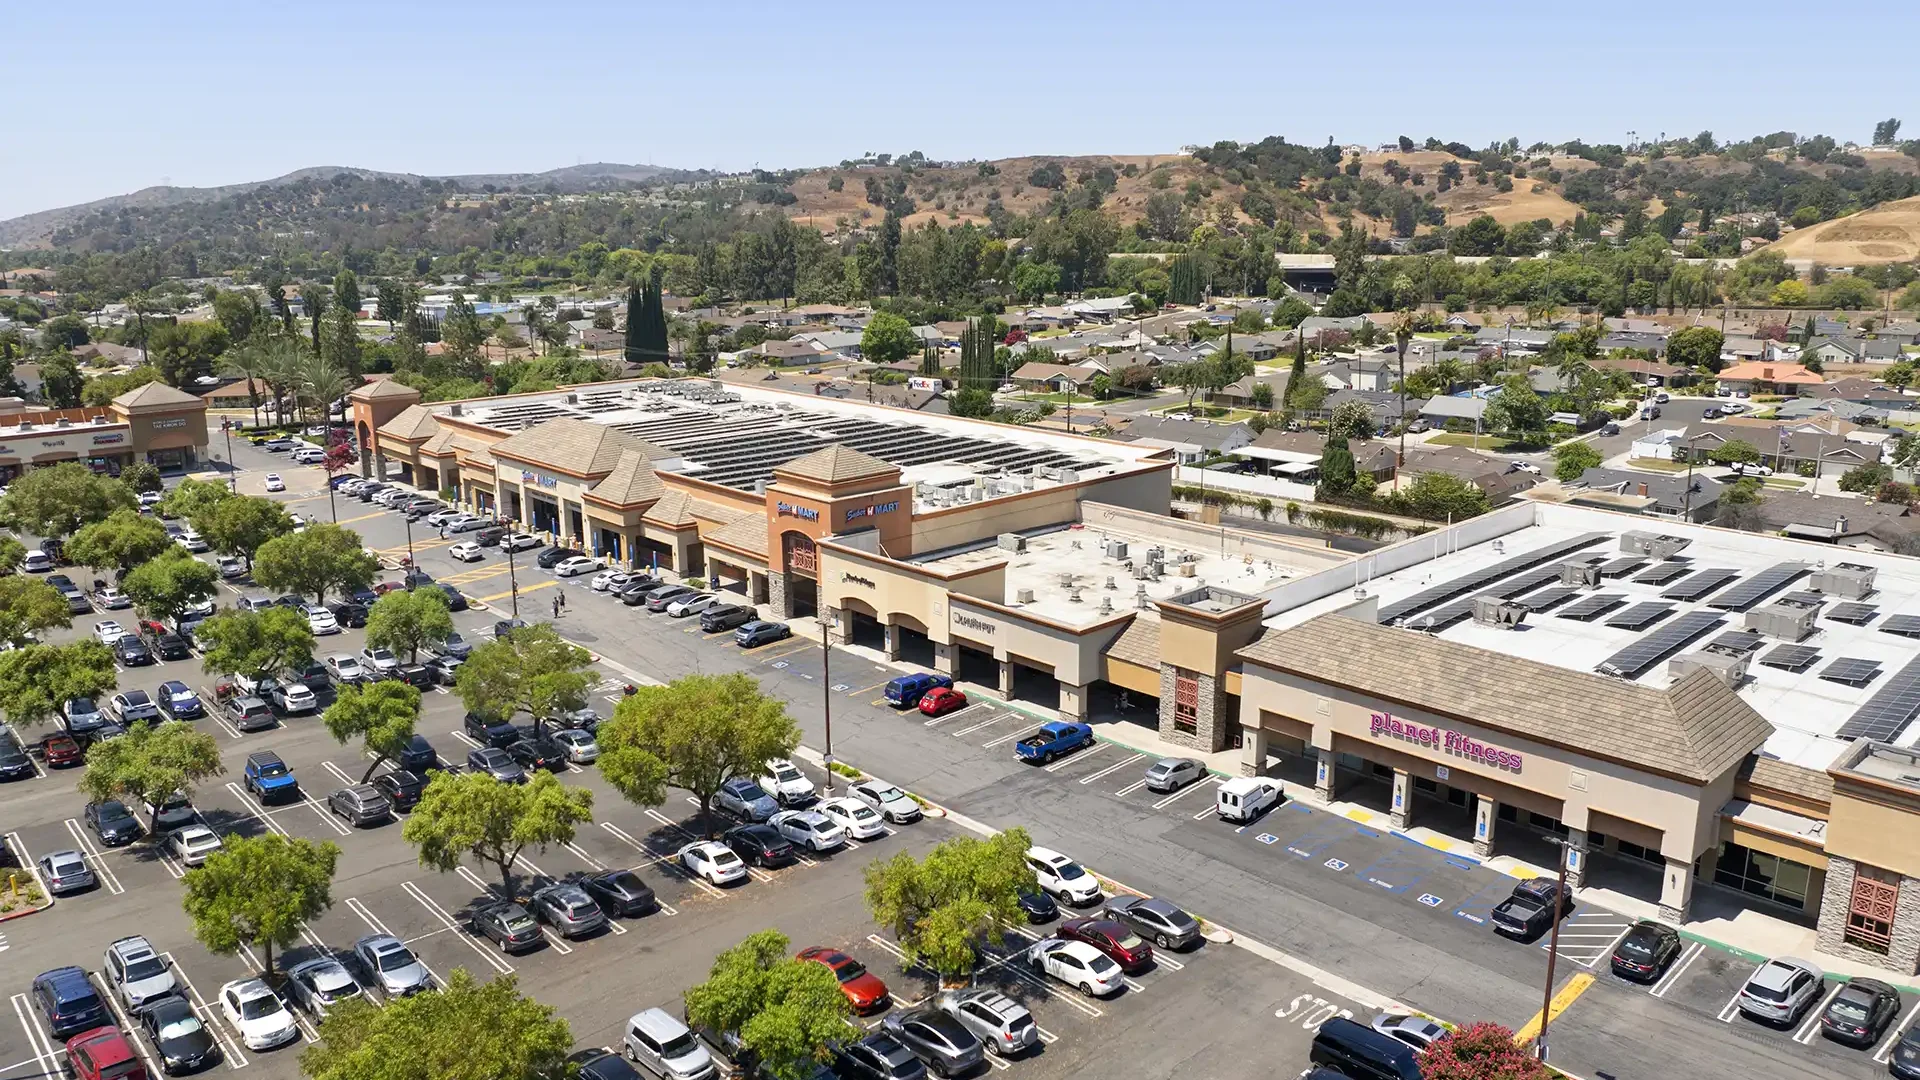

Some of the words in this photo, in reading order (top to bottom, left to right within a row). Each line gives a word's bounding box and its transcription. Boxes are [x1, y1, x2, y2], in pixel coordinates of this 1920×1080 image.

[914, 380, 931, 389] FedEx
[797, 506, 819, 520] MART
[867, 505, 875, 516] H
[874, 500, 900, 515] MART
[1369, 712, 1441, 744] planet
[1443, 729, 1522, 769] fitness
